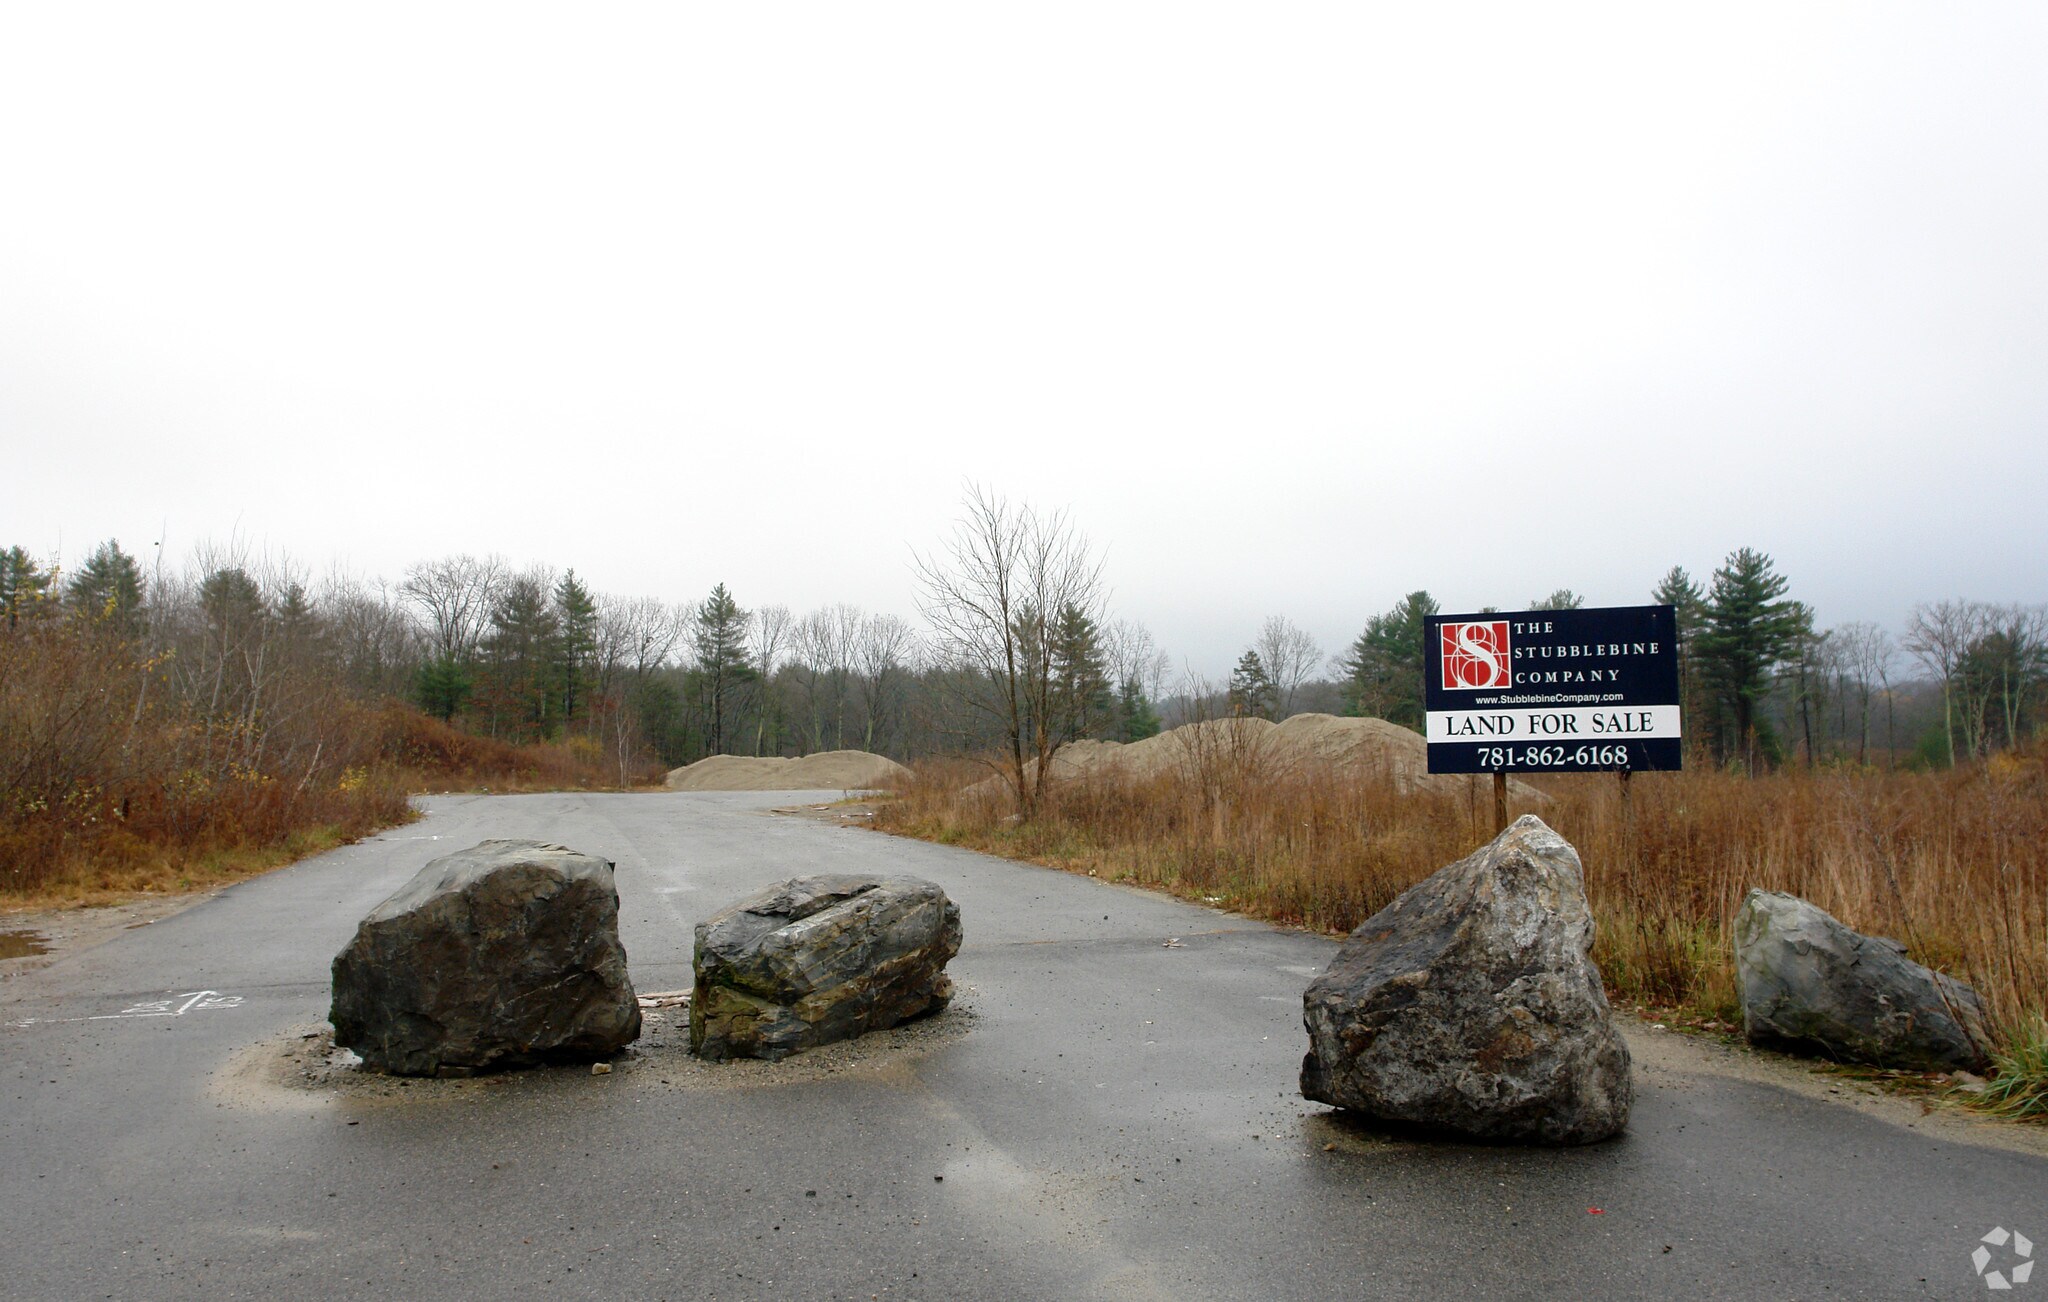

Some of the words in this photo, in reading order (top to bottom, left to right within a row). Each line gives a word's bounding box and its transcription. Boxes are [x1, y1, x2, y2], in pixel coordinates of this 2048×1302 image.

[1514, 622, 1554, 634] THE
[1515, 643, 1660, 659] STUBBLEBINE
[1516, 669, 1620, 684] COMPANY
[1475, 693, 1624, 705] www.StubblebineCompany.com
[1446, 715, 1515, 736] LAND
[1528, 714, 1579, 734] FOR
[1592, 712, 1654, 733] SALE
[1478, 746, 1628, 767] 781-862-6168
